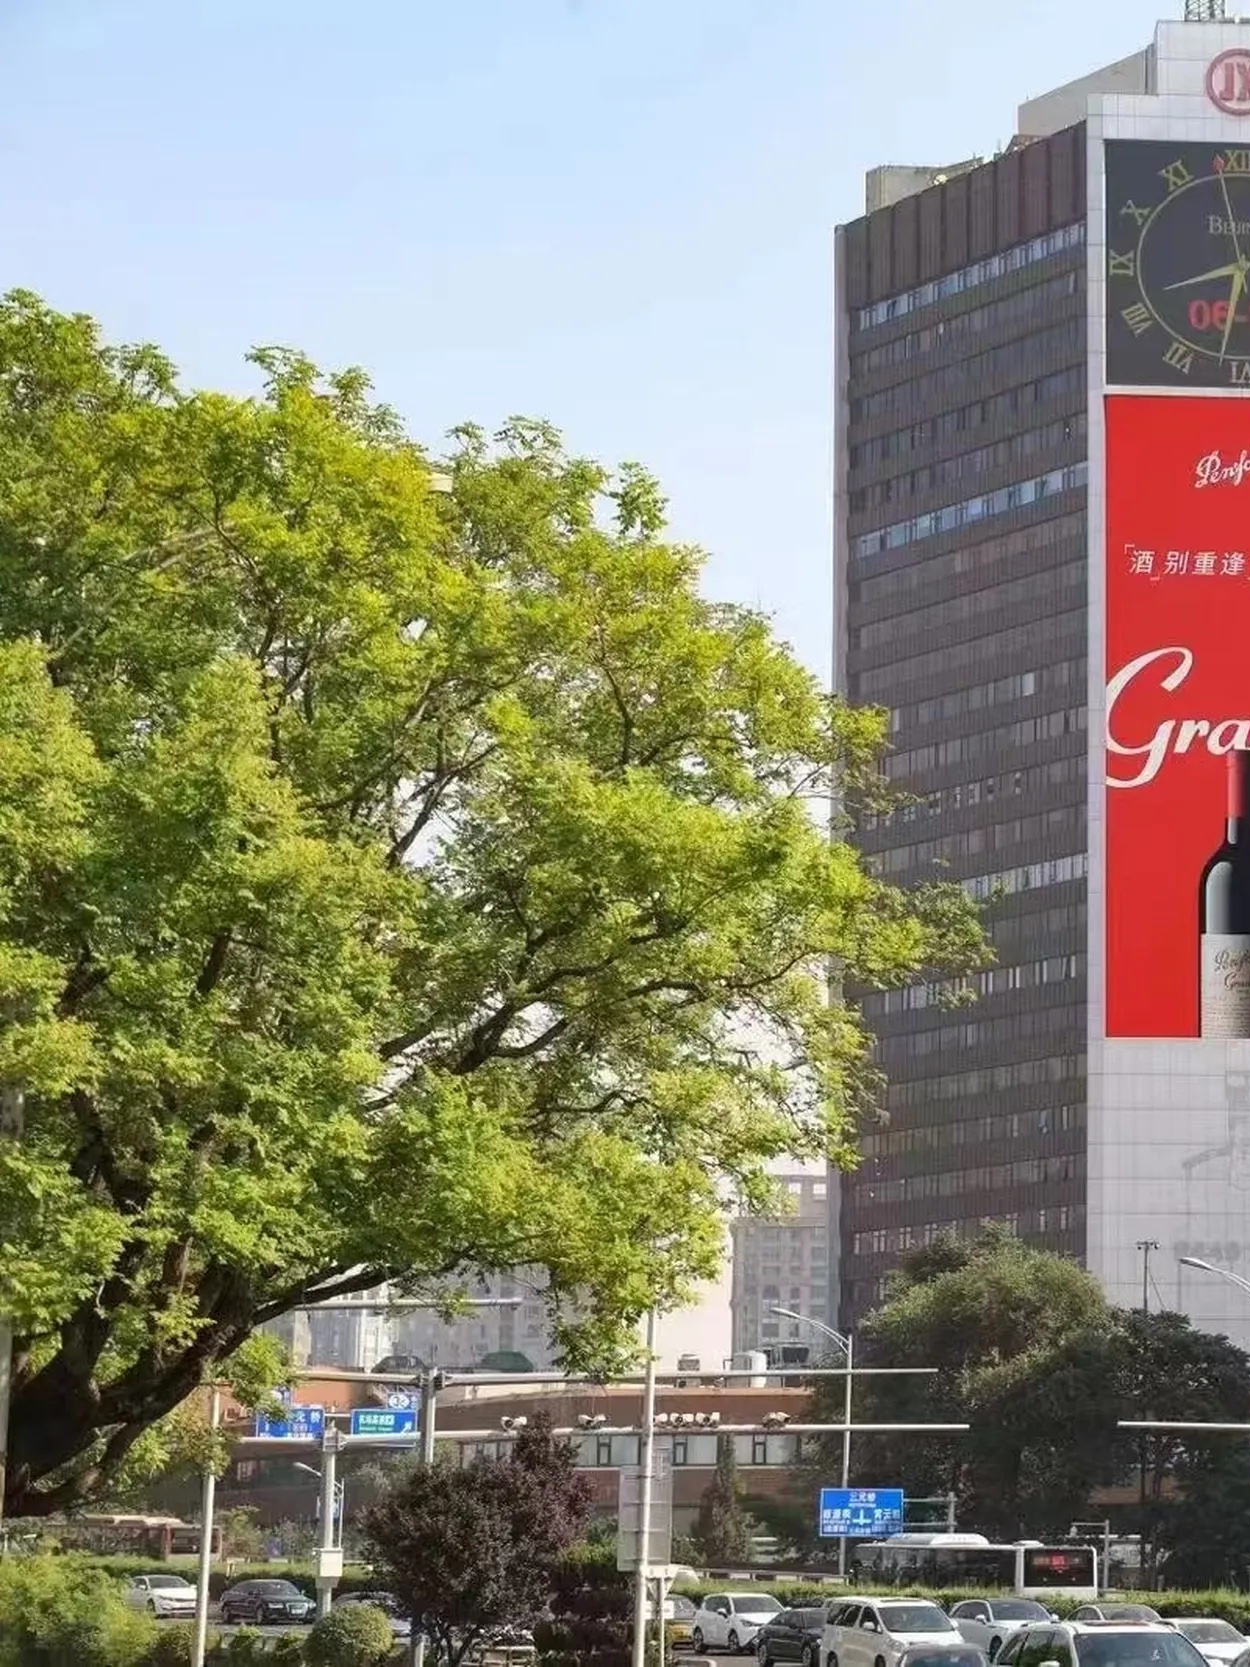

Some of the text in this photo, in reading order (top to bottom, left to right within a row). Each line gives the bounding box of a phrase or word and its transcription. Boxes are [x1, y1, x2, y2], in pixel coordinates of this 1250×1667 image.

[1159, 161, 1192, 191] XI
[1121, 200, 1150, 225] X
[1109, 249, 1134, 276] IX
[1162, 342, 1194, 374] VII
